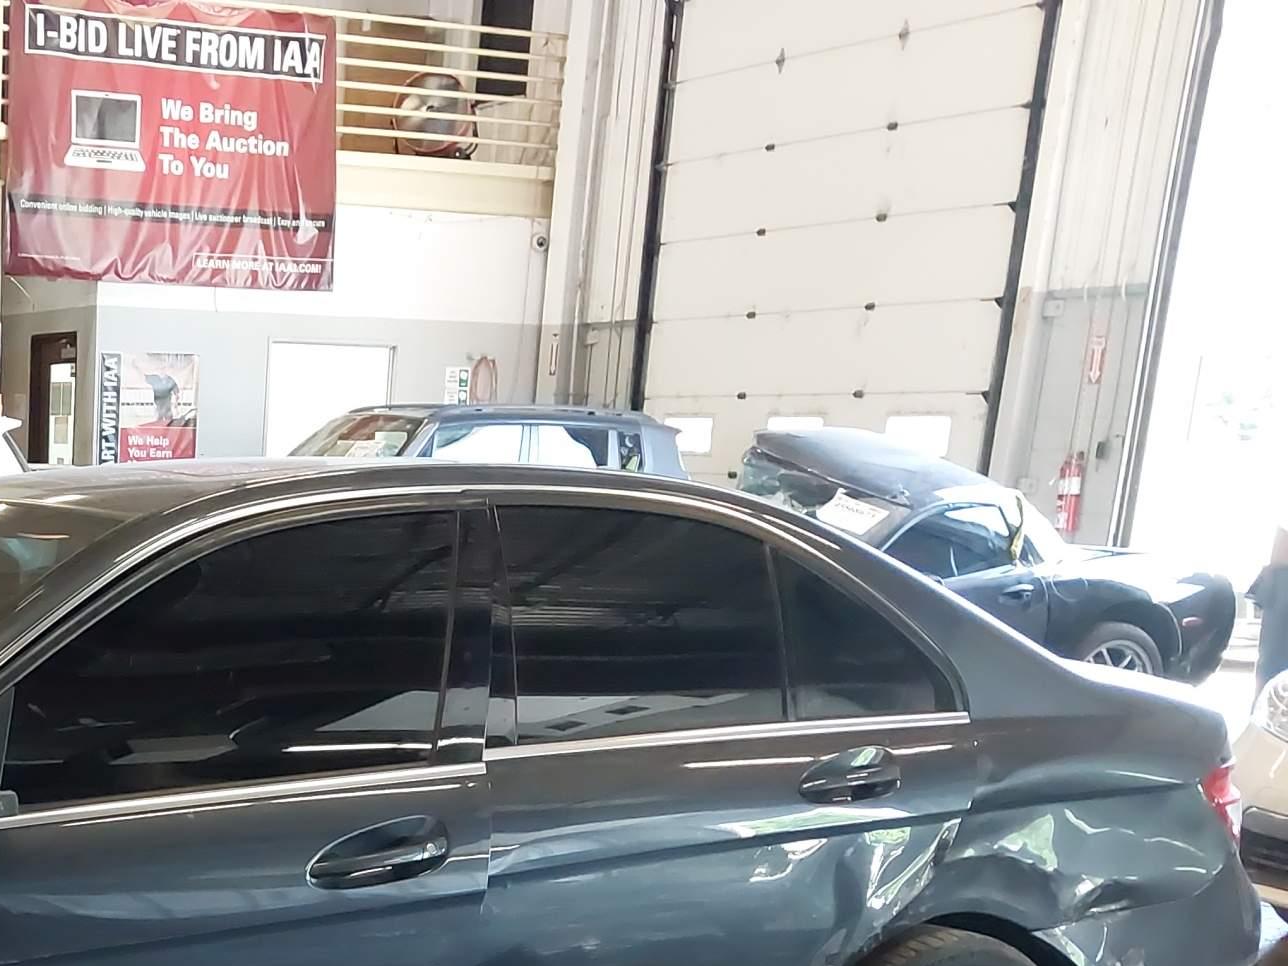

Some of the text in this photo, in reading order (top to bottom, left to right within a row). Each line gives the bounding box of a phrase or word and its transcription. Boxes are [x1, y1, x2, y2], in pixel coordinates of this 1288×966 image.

[36, 12, 320, 75] I-BID LIVE FROM IAA
[161, 98, 258, 132] We Bring
[159, 126, 289, 157] The Auction
[158, 153, 229, 179] To You
[20, 199, 57, 210] Convenient
[78, 203, 102, 215] bidding
[108, 206, 143, 218] High-quality
[144, 209, 167, 218] vehicle
[169, 210, 190, 221] images
[195, 211, 207, 221] Live
[208, 213, 241, 223] auctioneer
[196, 257, 229, 269] LEARN
[231, 260, 259, 271] MORE
[261, 262, 274, 272] AT
[103, 357, 118, 387] IAA
[101, 391, 118, 436] WITH
[127, 434, 169, 448] We Help
[127, 447, 173, 458] You Earn
